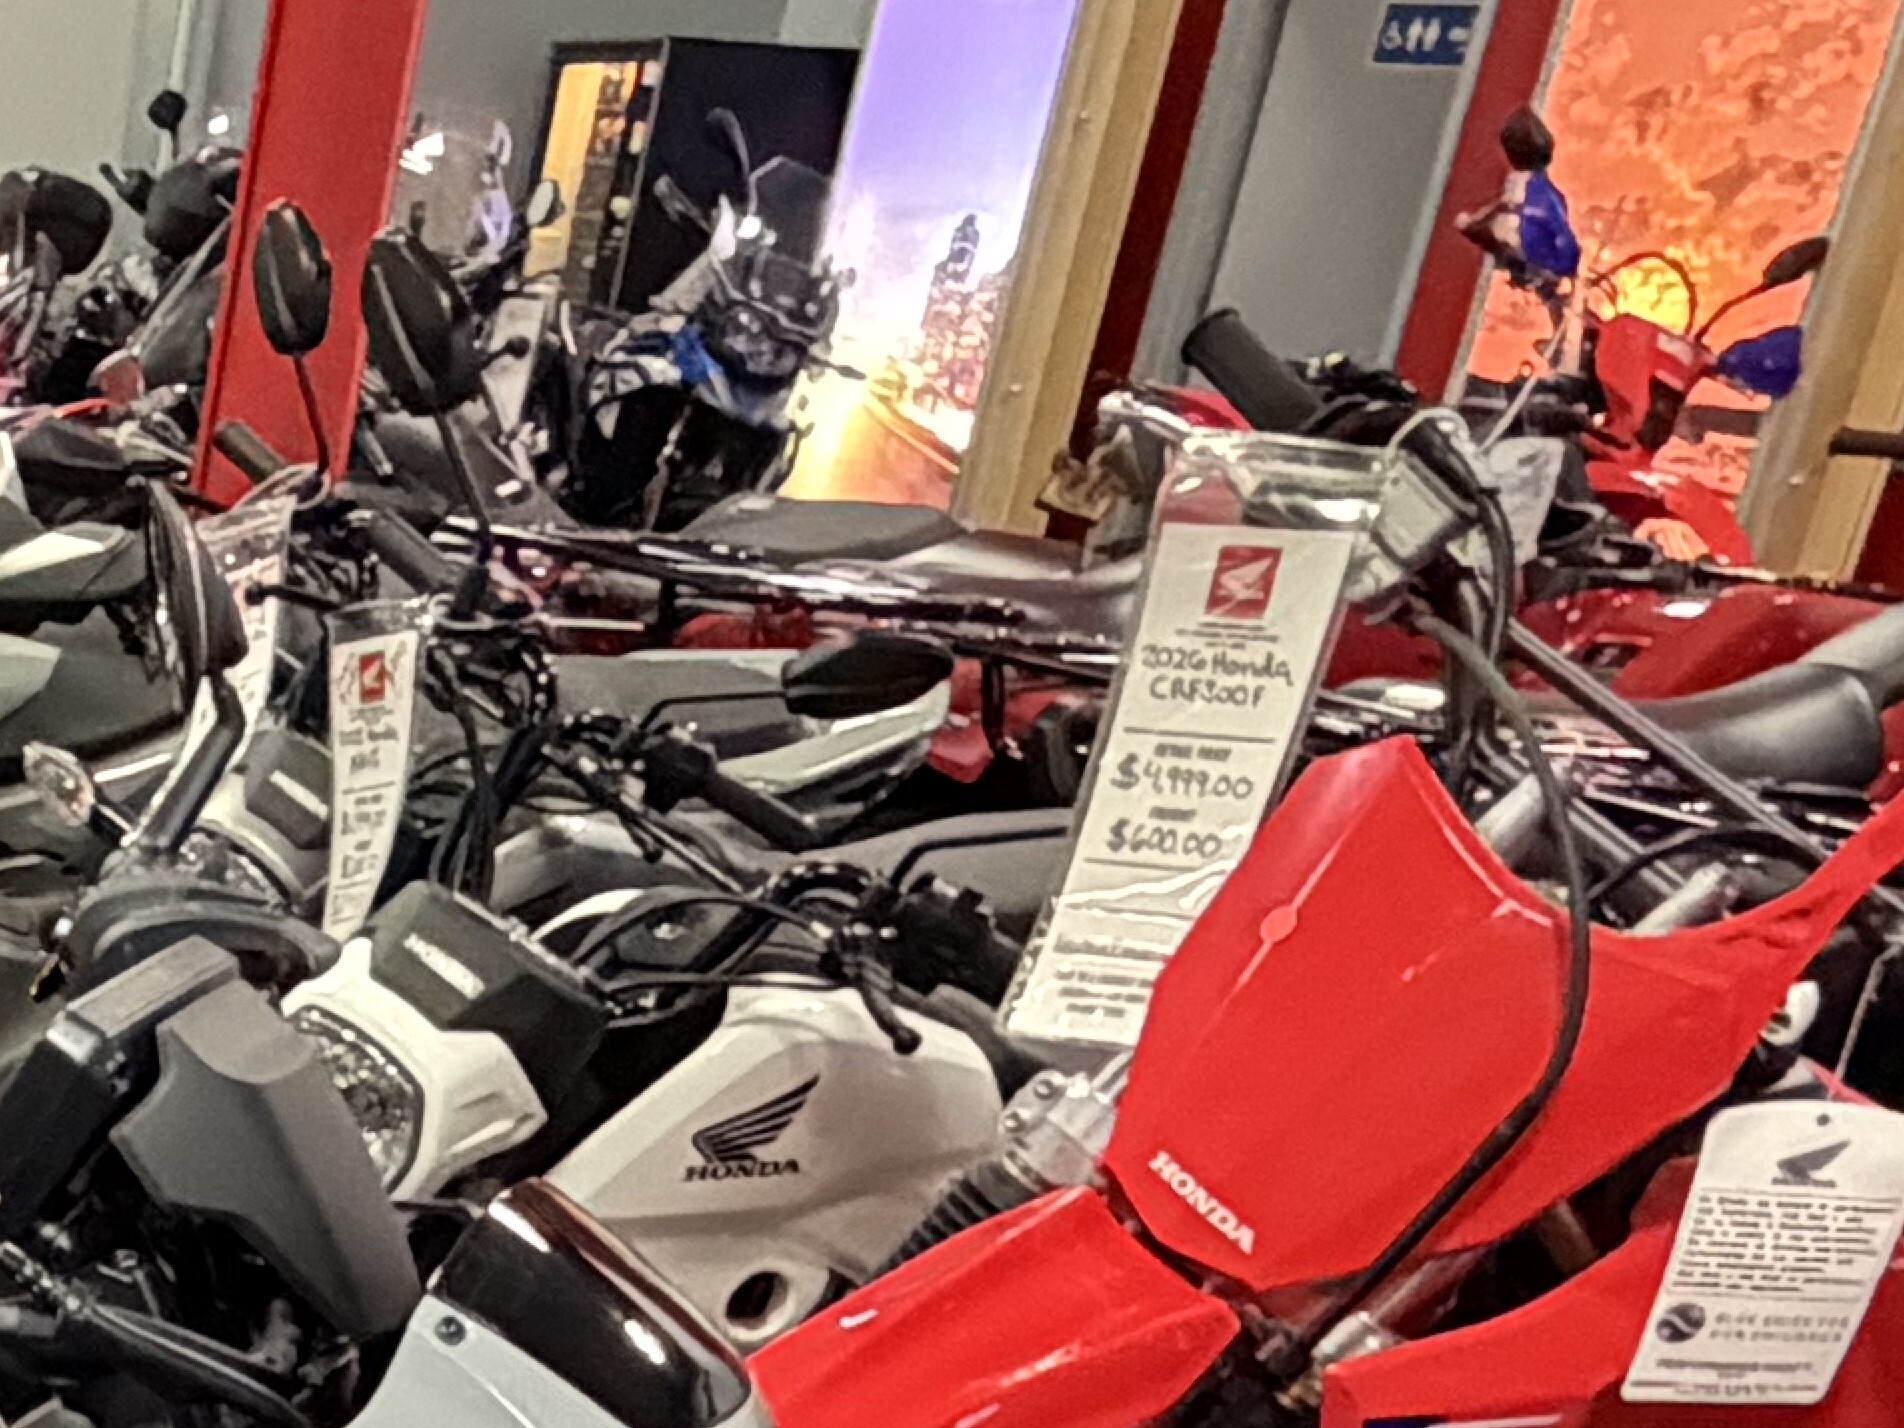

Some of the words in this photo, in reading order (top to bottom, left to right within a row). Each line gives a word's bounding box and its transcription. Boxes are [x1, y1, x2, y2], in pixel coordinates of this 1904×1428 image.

[1211, 650, 1295, 687] Honda
[681, 1158, 800, 1182] HONDA
[1148, 1150, 1256, 1256] HONDA
